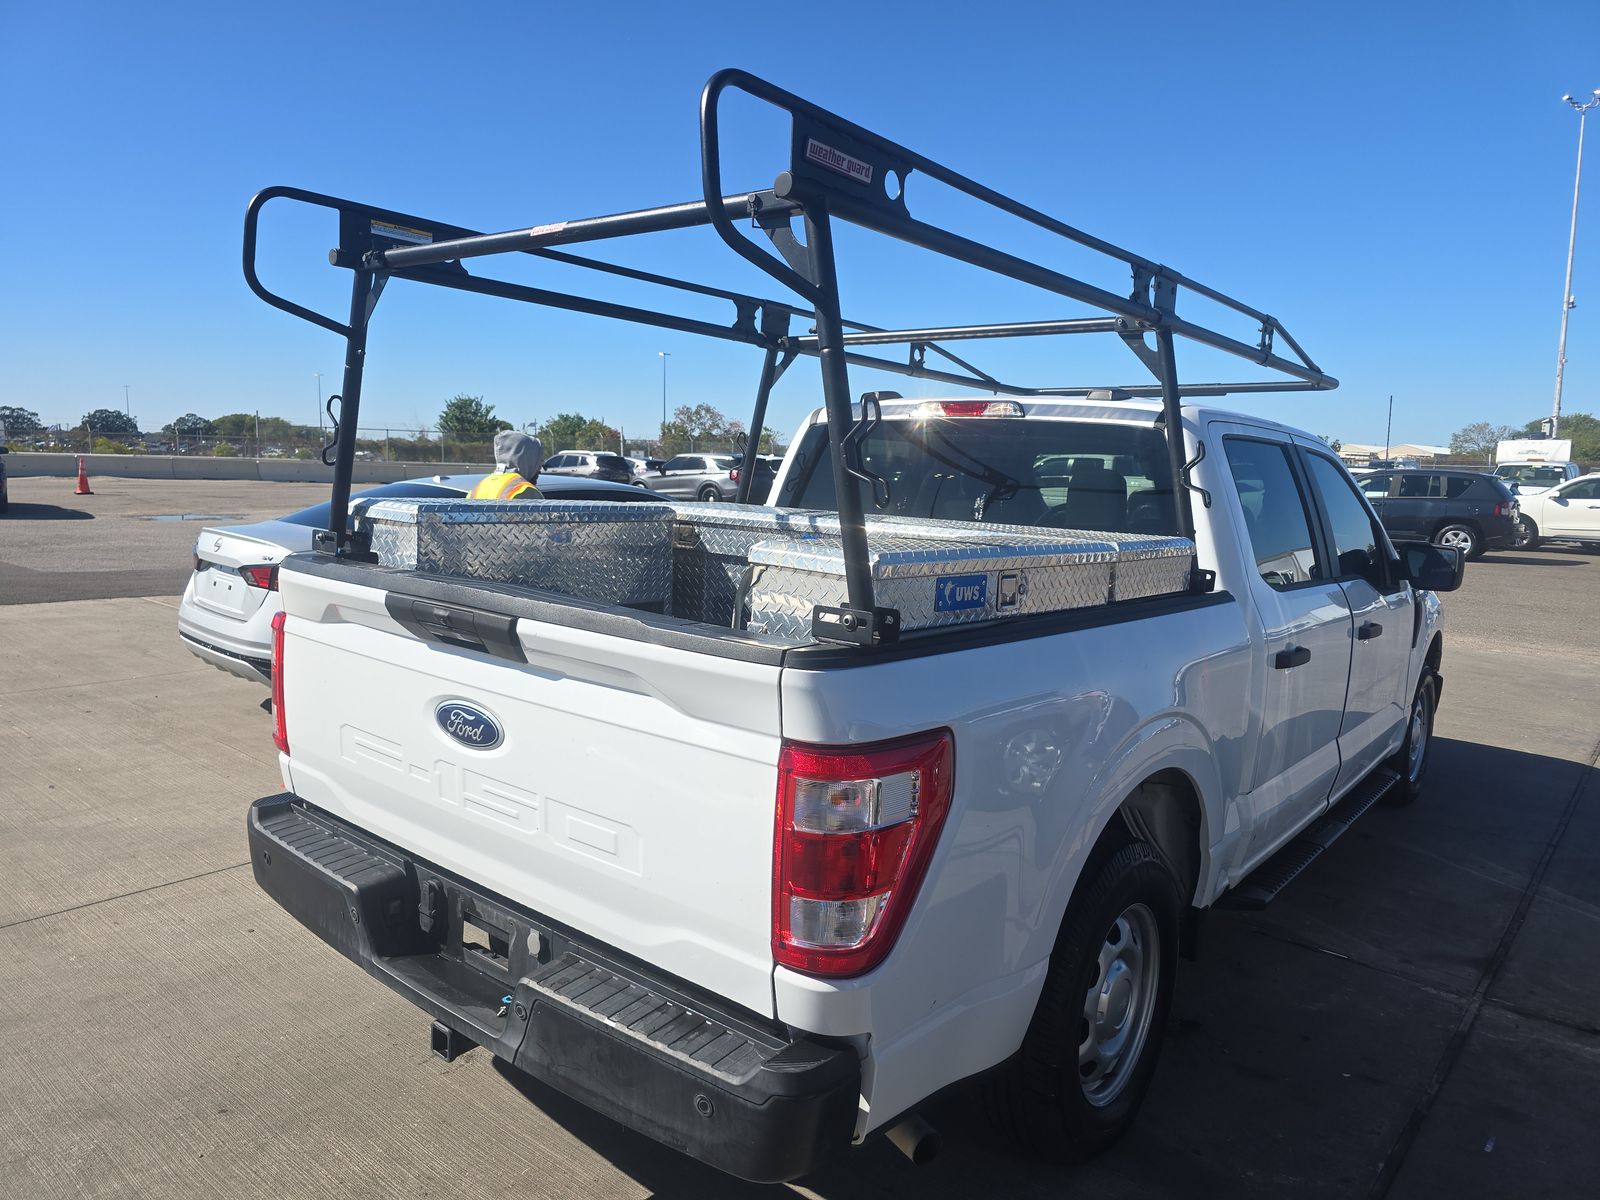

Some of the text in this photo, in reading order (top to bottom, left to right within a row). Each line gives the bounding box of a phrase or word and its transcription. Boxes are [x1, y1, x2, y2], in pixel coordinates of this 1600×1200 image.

[809, 142, 871, 178] weather guard
[955, 585, 980, 601] UWS
[447, 709, 484, 741] Ford
